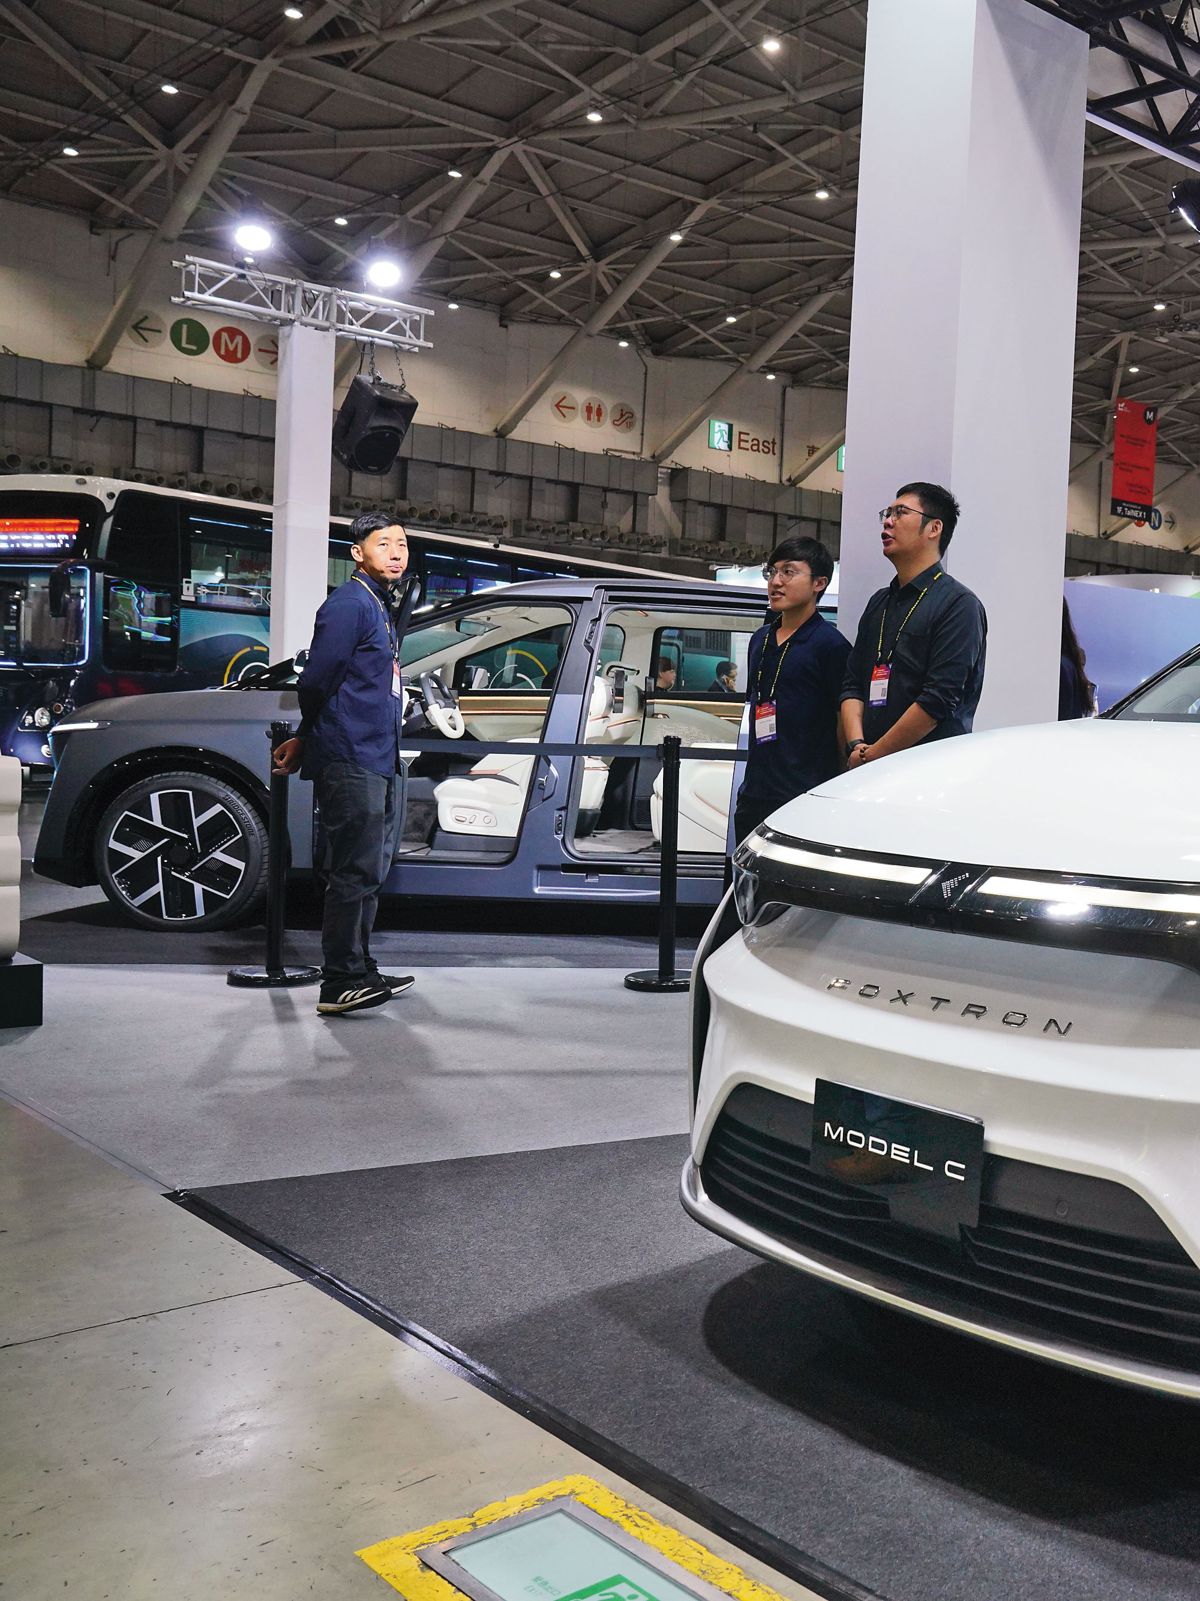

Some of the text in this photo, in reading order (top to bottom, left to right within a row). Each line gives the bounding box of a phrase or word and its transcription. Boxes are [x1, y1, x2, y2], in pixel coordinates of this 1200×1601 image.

[737, 431, 777, 456] East
[827, 977, 1073, 1037] FOXTRON
[824, 1121, 966, 1182] MODEL C
